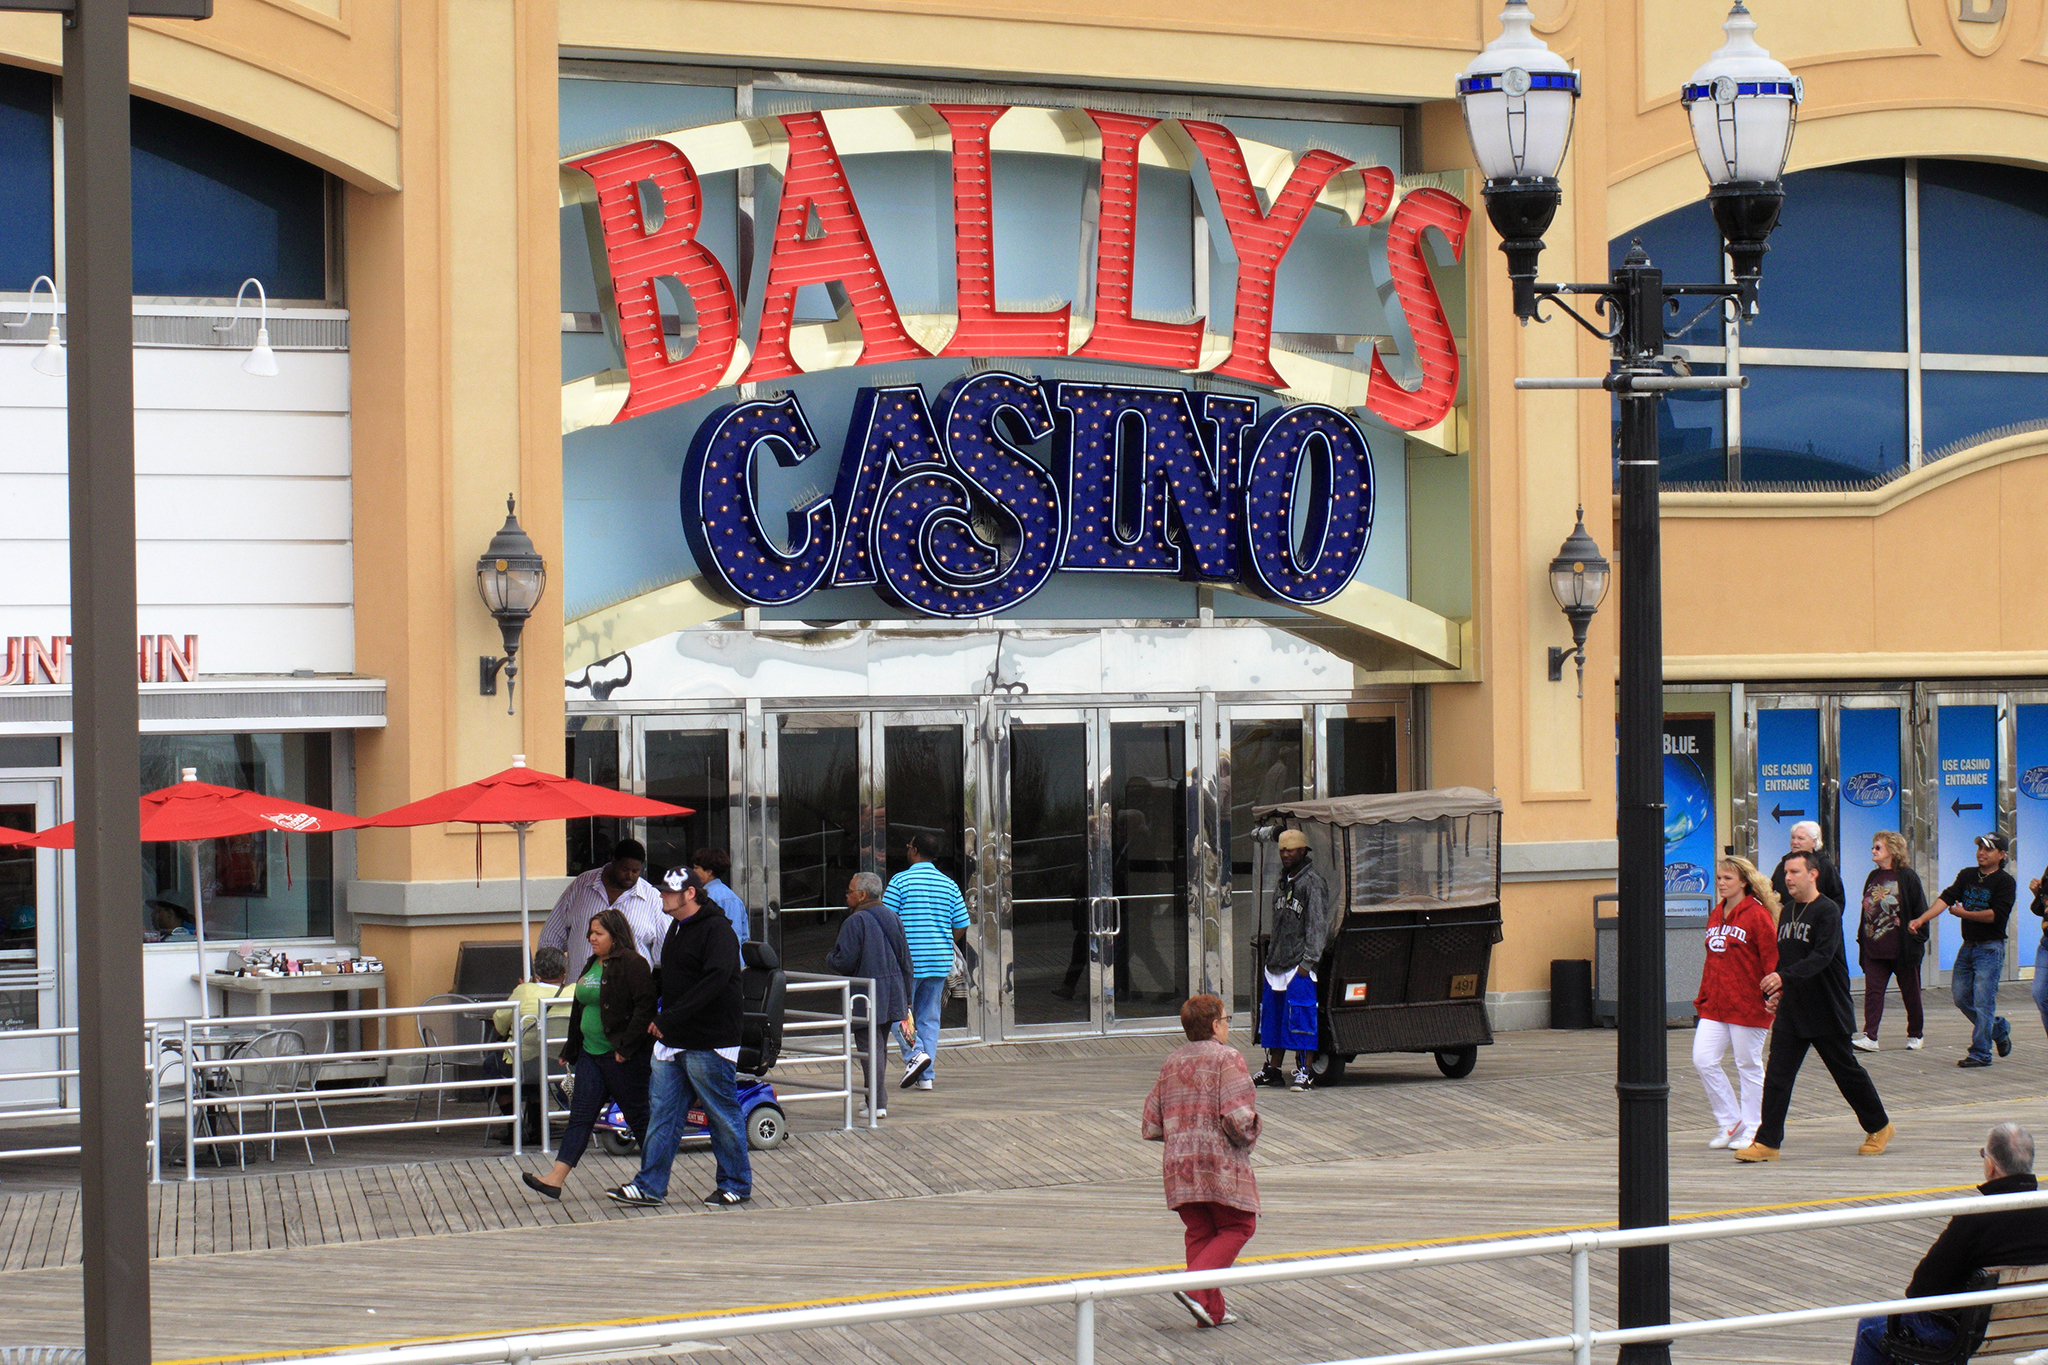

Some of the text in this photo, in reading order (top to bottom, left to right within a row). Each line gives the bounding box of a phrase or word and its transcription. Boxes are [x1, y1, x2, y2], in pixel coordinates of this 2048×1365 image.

[561, 104, 1472, 432] BALLY'S
[682, 370, 1376, 619] CASINO
[1663, 733, 1699, 754] BLUE.
[1761, 763, 1813, 776] USE CASINO
[1942, 758, 1991, 771] USE CASINO
[1765, 778, 1810, 791] ENTRANCE
[1847, 775, 1868, 791] Blue
[1945, 773, 1988, 786] ENTRANCE
[1777, 921, 1812, 943] ENYCE
[1454, 980, 1474, 992] 491
